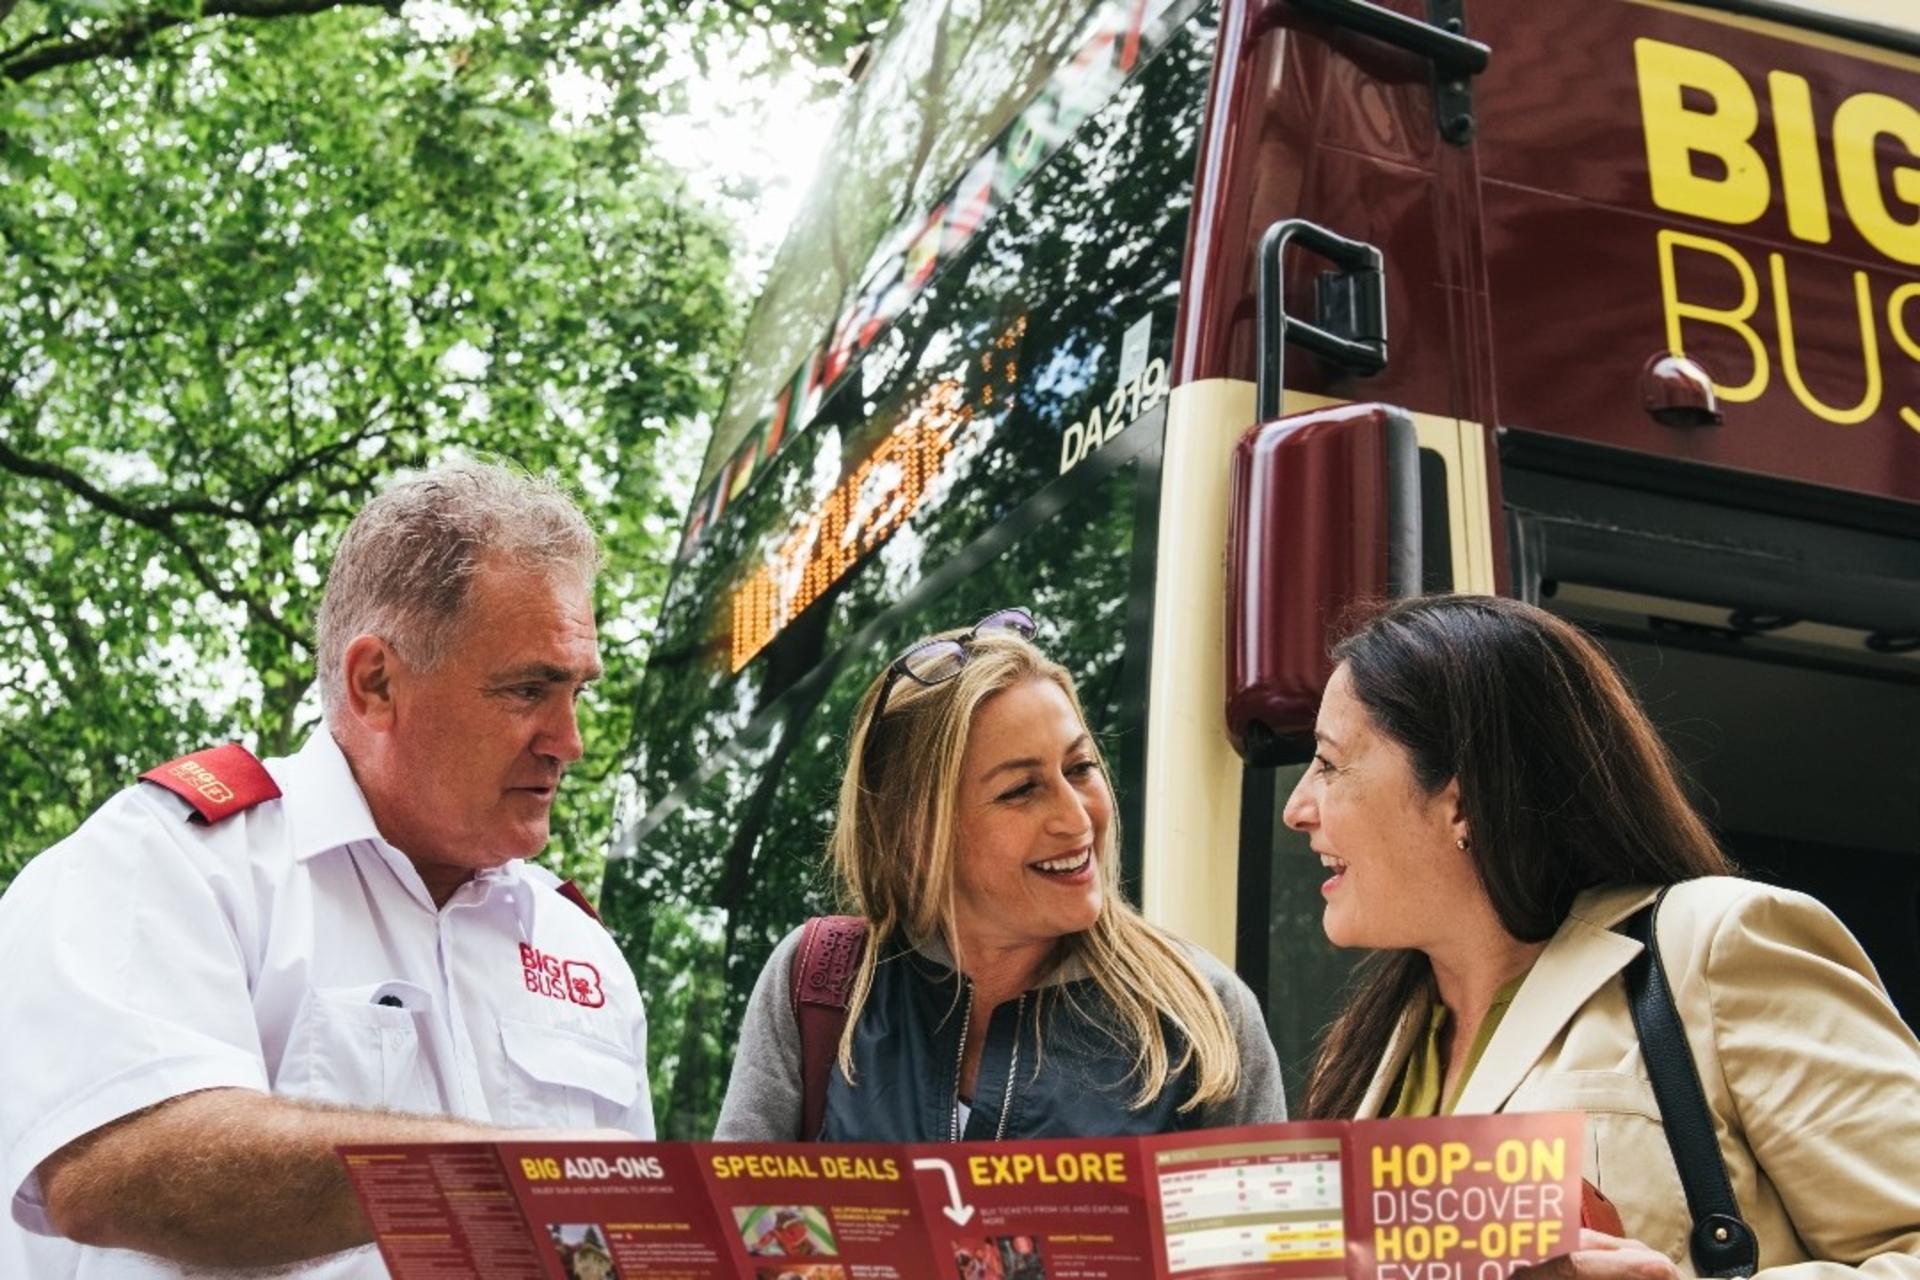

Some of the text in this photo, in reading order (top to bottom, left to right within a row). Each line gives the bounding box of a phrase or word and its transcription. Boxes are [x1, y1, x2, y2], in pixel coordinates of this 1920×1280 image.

[1634, 37, 1920, 266] BIG
[1059, 357, 1167, 476] DA219
[519, 942, 560, 978] BIG
[524, 969, 566, 1000] BUS
[520, 1157, 561, 1180] BIG
[564, 1156, 665, 1180] ADD-ONS
[711, 1154, 900, 1181] SPECIAL DEALS
[968, 1152, 1128, 1186] EXPLORE
[1371, 1137, 1566, 1188] HOP-ON
[1372, 1183, 1565, 1225] DISCOVER
[1374, 1220, 1563, 1262] HOP-OFF
